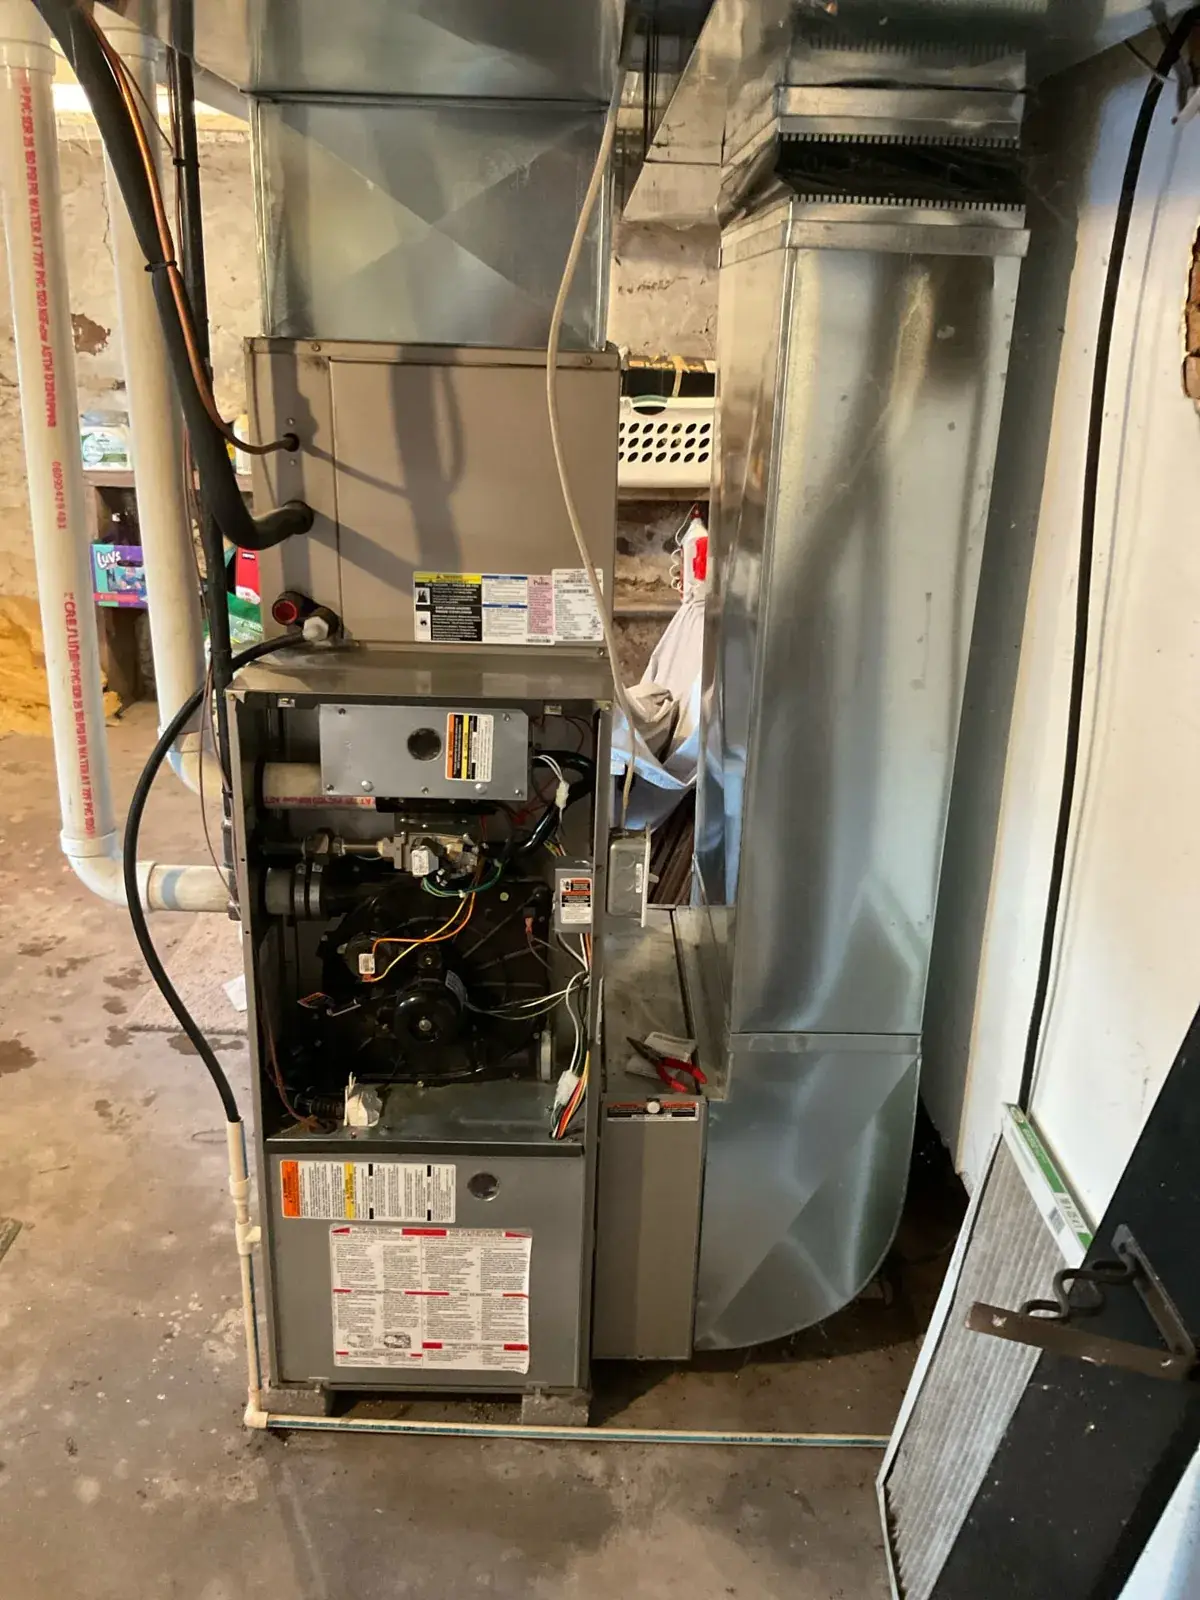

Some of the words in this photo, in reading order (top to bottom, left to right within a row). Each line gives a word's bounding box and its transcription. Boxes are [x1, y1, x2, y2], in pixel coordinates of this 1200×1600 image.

[28, 197, 41, 233] WATER
[31, 234, 43, 249] AT
[78, 746, 88, 773] WATER
